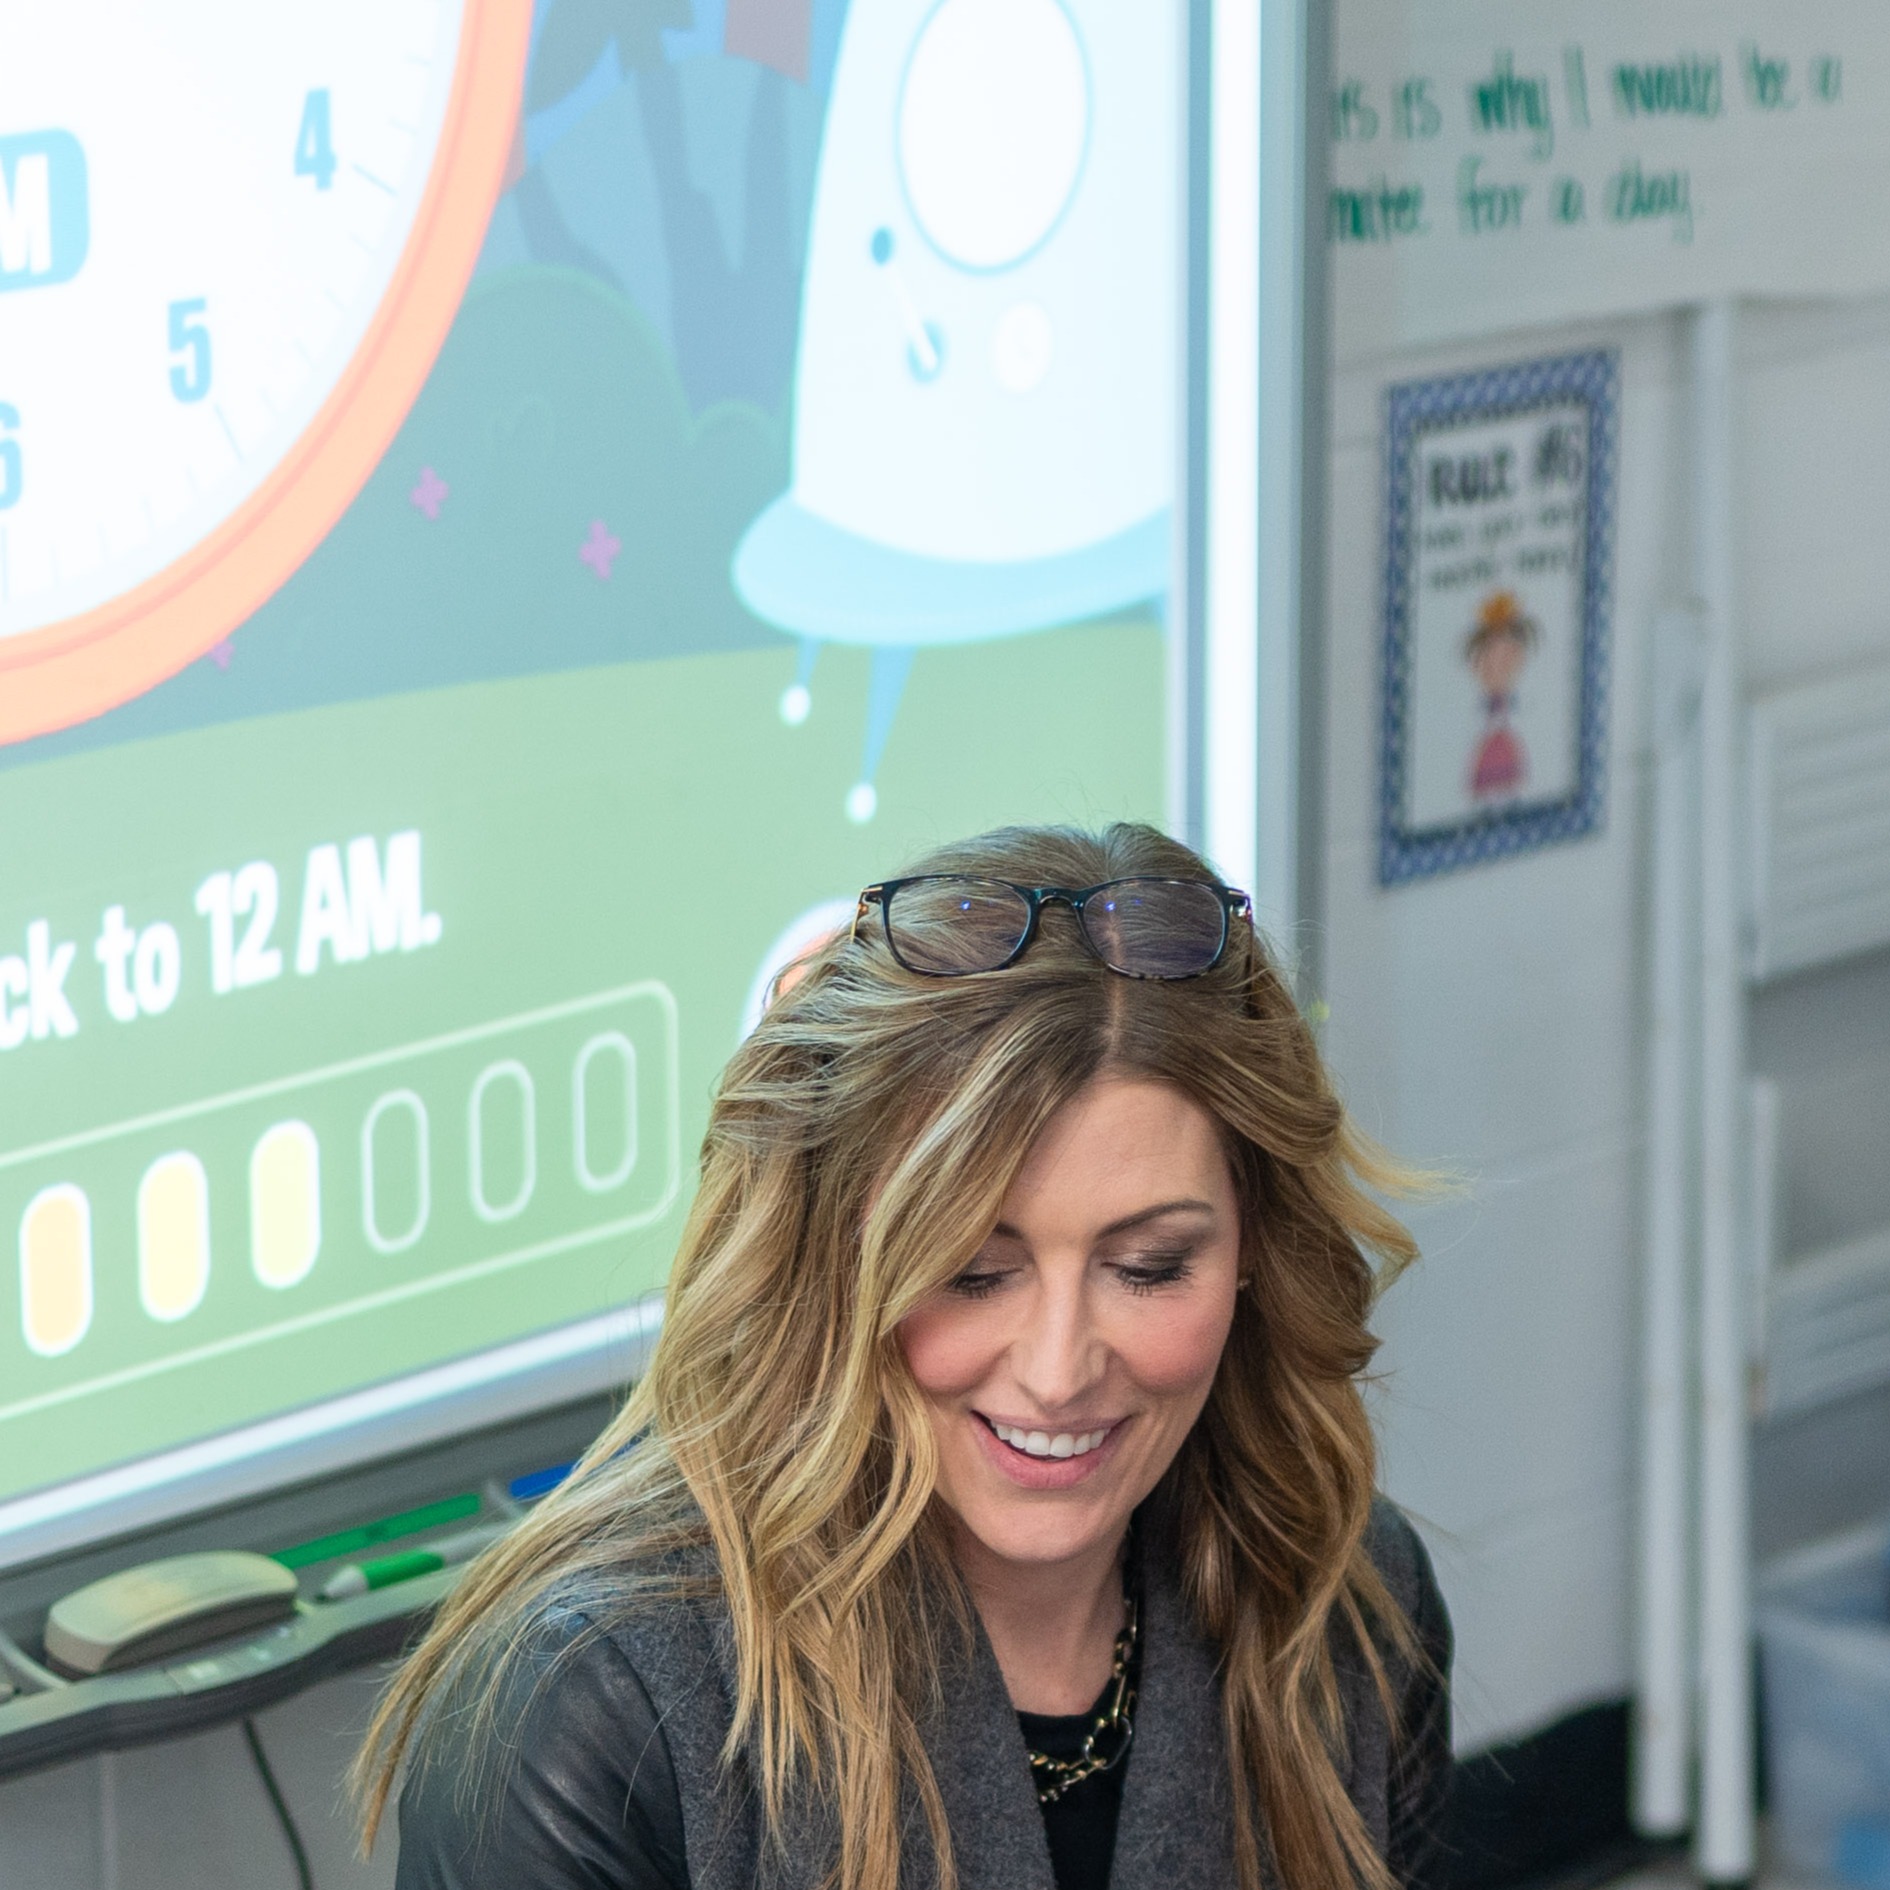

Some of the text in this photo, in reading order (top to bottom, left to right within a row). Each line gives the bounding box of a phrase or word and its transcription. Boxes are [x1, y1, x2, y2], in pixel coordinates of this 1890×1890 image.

[294, 86, 337, 191] 4
[1390, 75, 1443, 139] is
[1471, 48, 1556, 163] why
[1455, 154, 1529, 234] for
[167, 298, 212, 404] 5
[0, 829, 443, 1051] ck to 12 AM.
